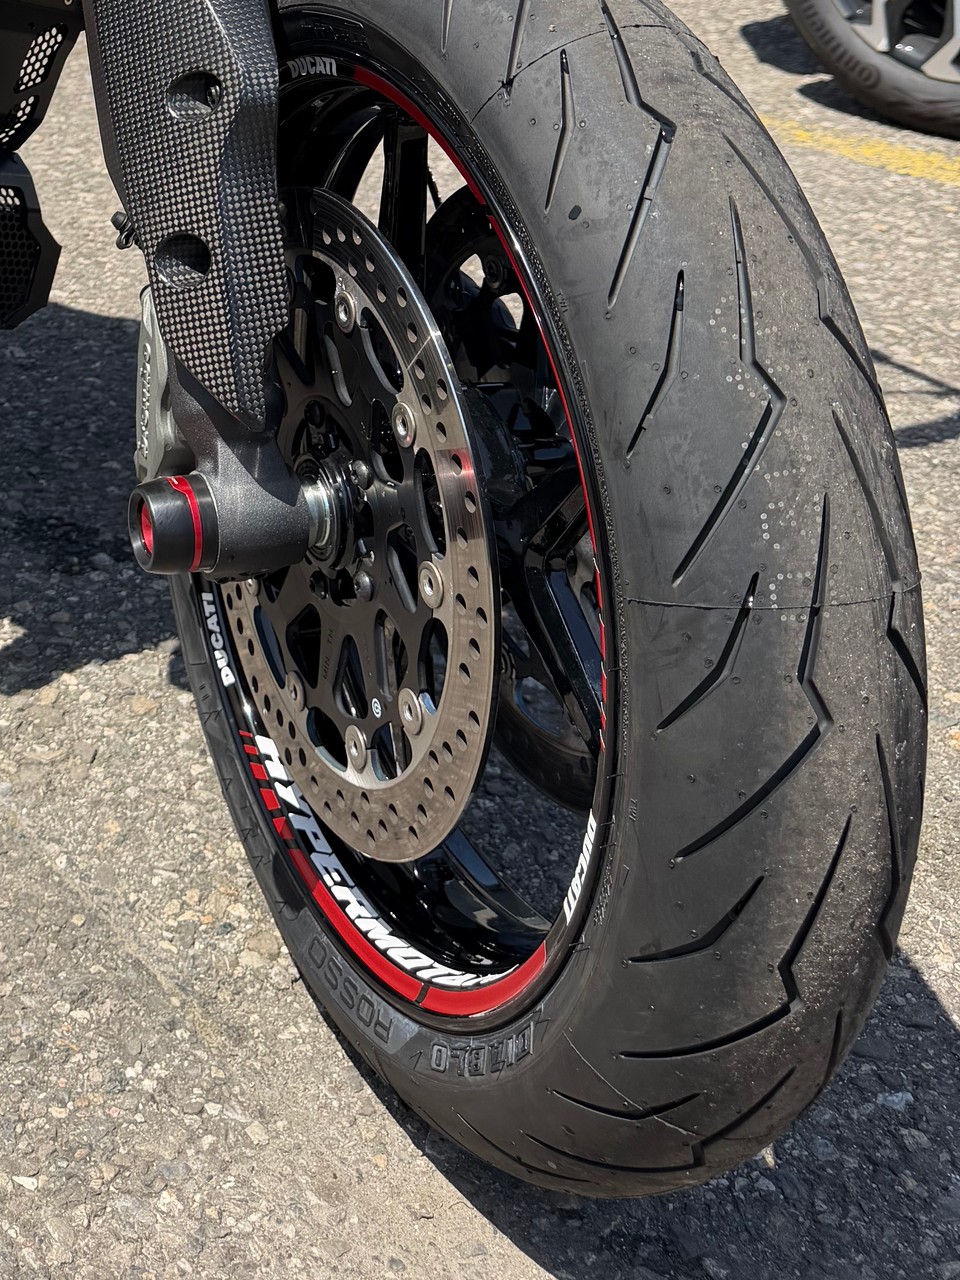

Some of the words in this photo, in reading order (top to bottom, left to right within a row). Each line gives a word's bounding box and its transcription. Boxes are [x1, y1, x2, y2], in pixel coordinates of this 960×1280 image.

[287, 56, 338, 79] DUCATI
[201, 592, 236, 688] DUCATI
[563, 807, 597, 926] DUCATI
[307, 935, 393, 1044] ROSSO
[429, 1020, 534, 1077] DIABLO
